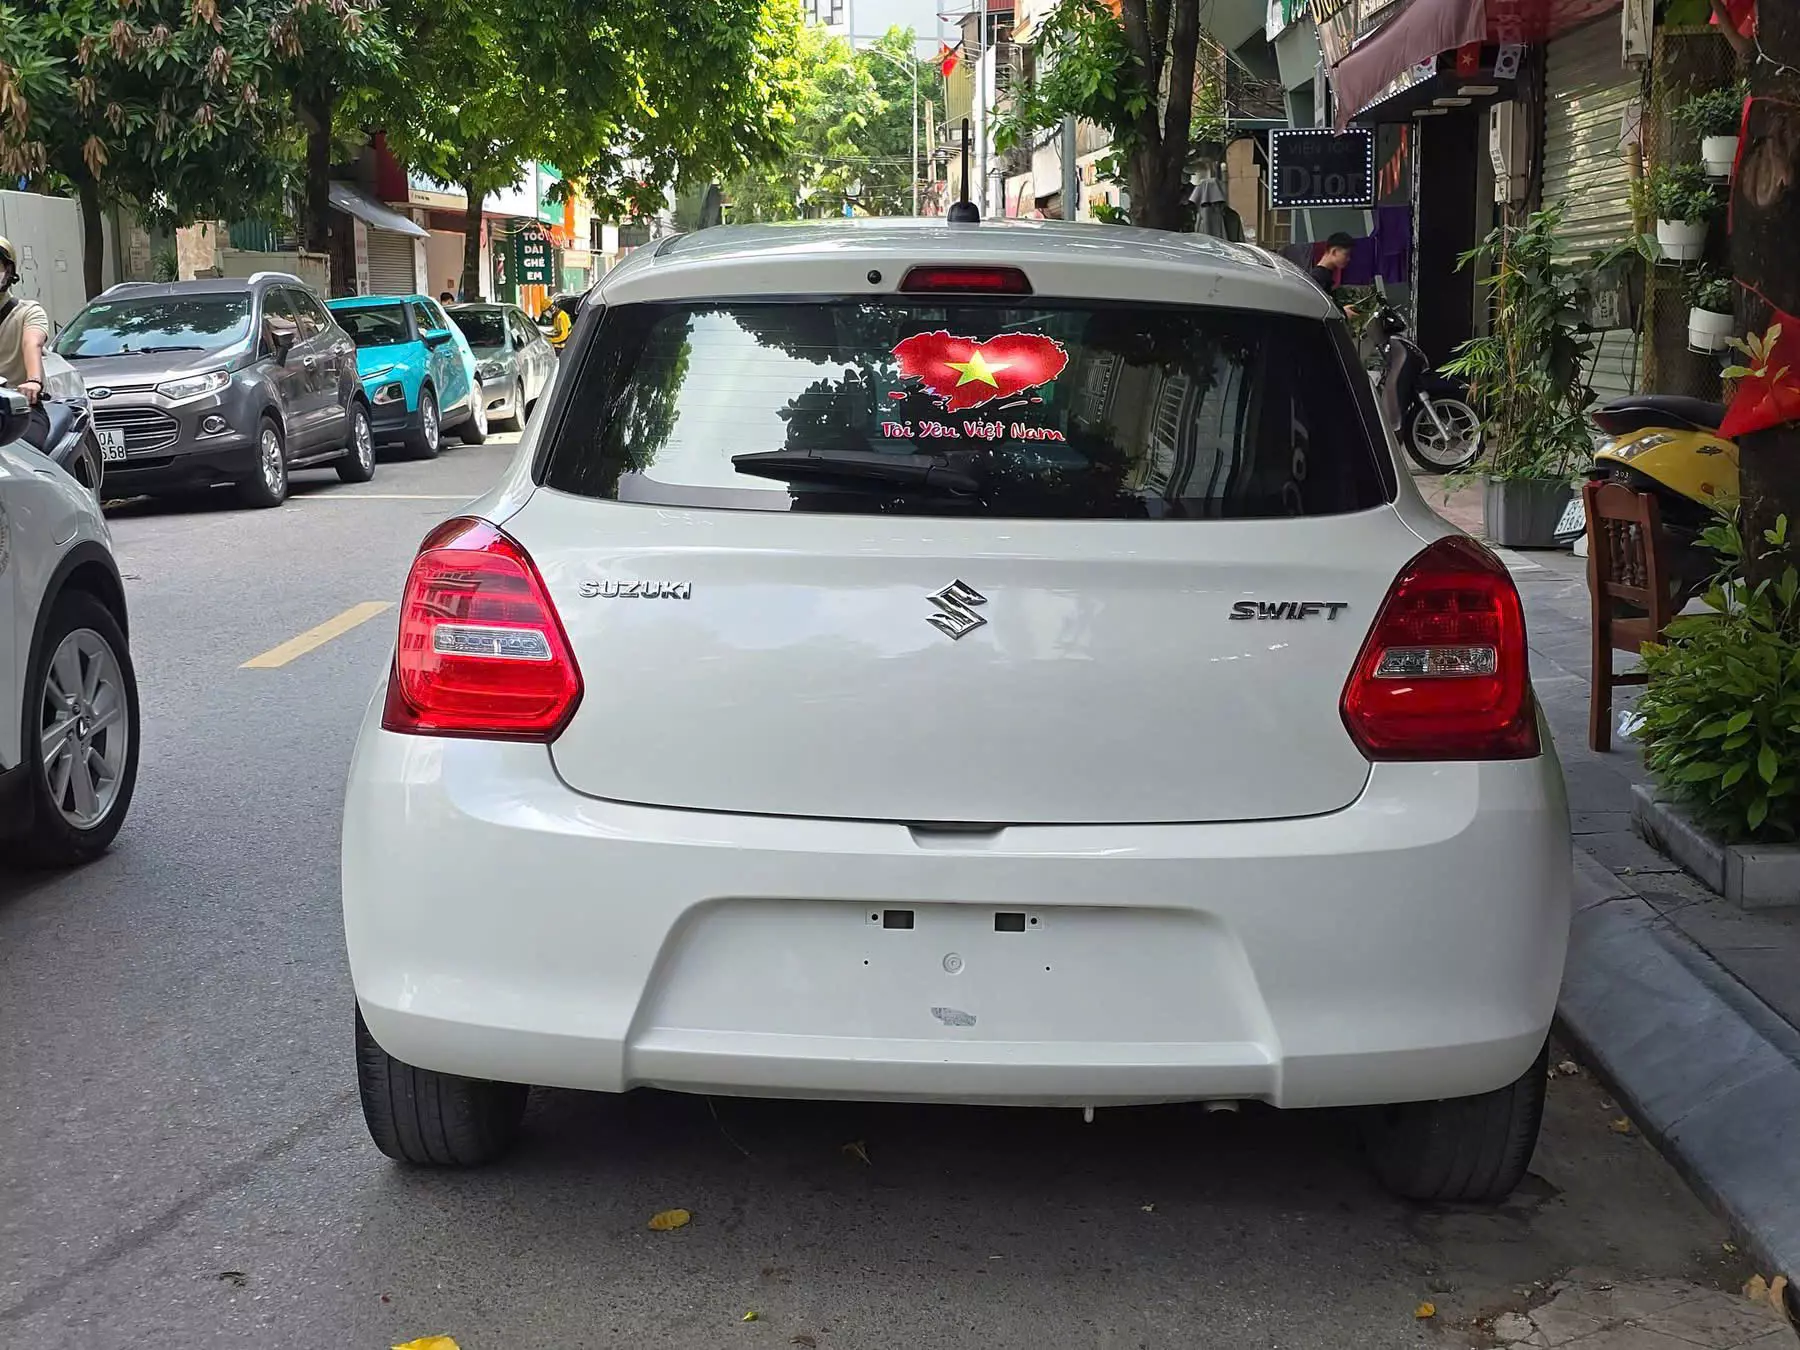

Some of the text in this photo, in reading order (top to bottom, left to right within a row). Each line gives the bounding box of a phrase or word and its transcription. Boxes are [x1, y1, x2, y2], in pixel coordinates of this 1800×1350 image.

[1278, 163, 1366, 198] Dior
[526, 271, 543, 281] EM
[880, 419, 1066, 442] Tôi Yêu Việt Nam
[577, 579, 692, 600] SUZUKI
[1228, 600, 1348, 621] SWIFT
